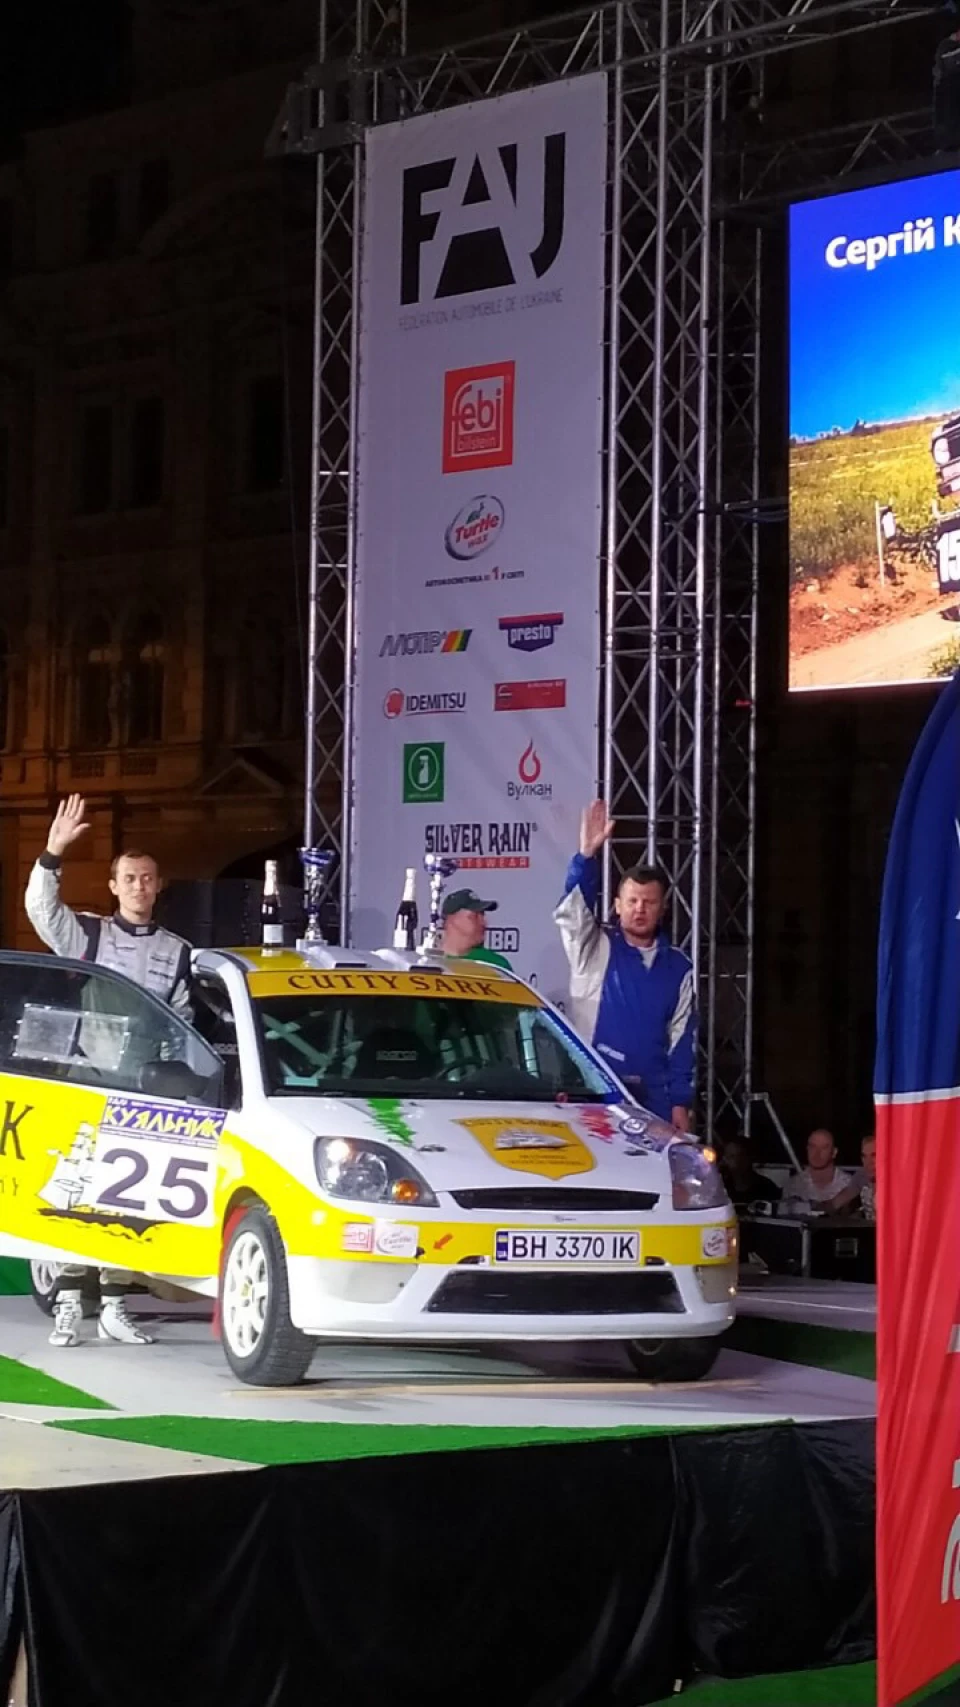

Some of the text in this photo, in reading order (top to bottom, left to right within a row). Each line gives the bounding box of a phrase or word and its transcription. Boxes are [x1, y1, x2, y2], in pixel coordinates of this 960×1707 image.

[825, 216, 936, 271] Сергій
[453, 384, 502, 432] febi
[455, 512, 500, 544] Turtle
[492, 566, 499, 580] 1
[379, 631, 442, 657] MOTIP
[510, 624, 551, 643] presto
[406, 692, 466, 711] IDEMITSU
[507, 781, 552, 800] Вулкан
[424, 822, 531, 856] SILVER RAIN
[287, 973, 400, 991] CUTTY
[409, 975, 503, 997] SARK
[103, 1104, 224, 1139] КУЯЛЬНИК
[95, 1147, 209, 1219] 25
[511, 1235, 634, 1259] BH 3370 IK
